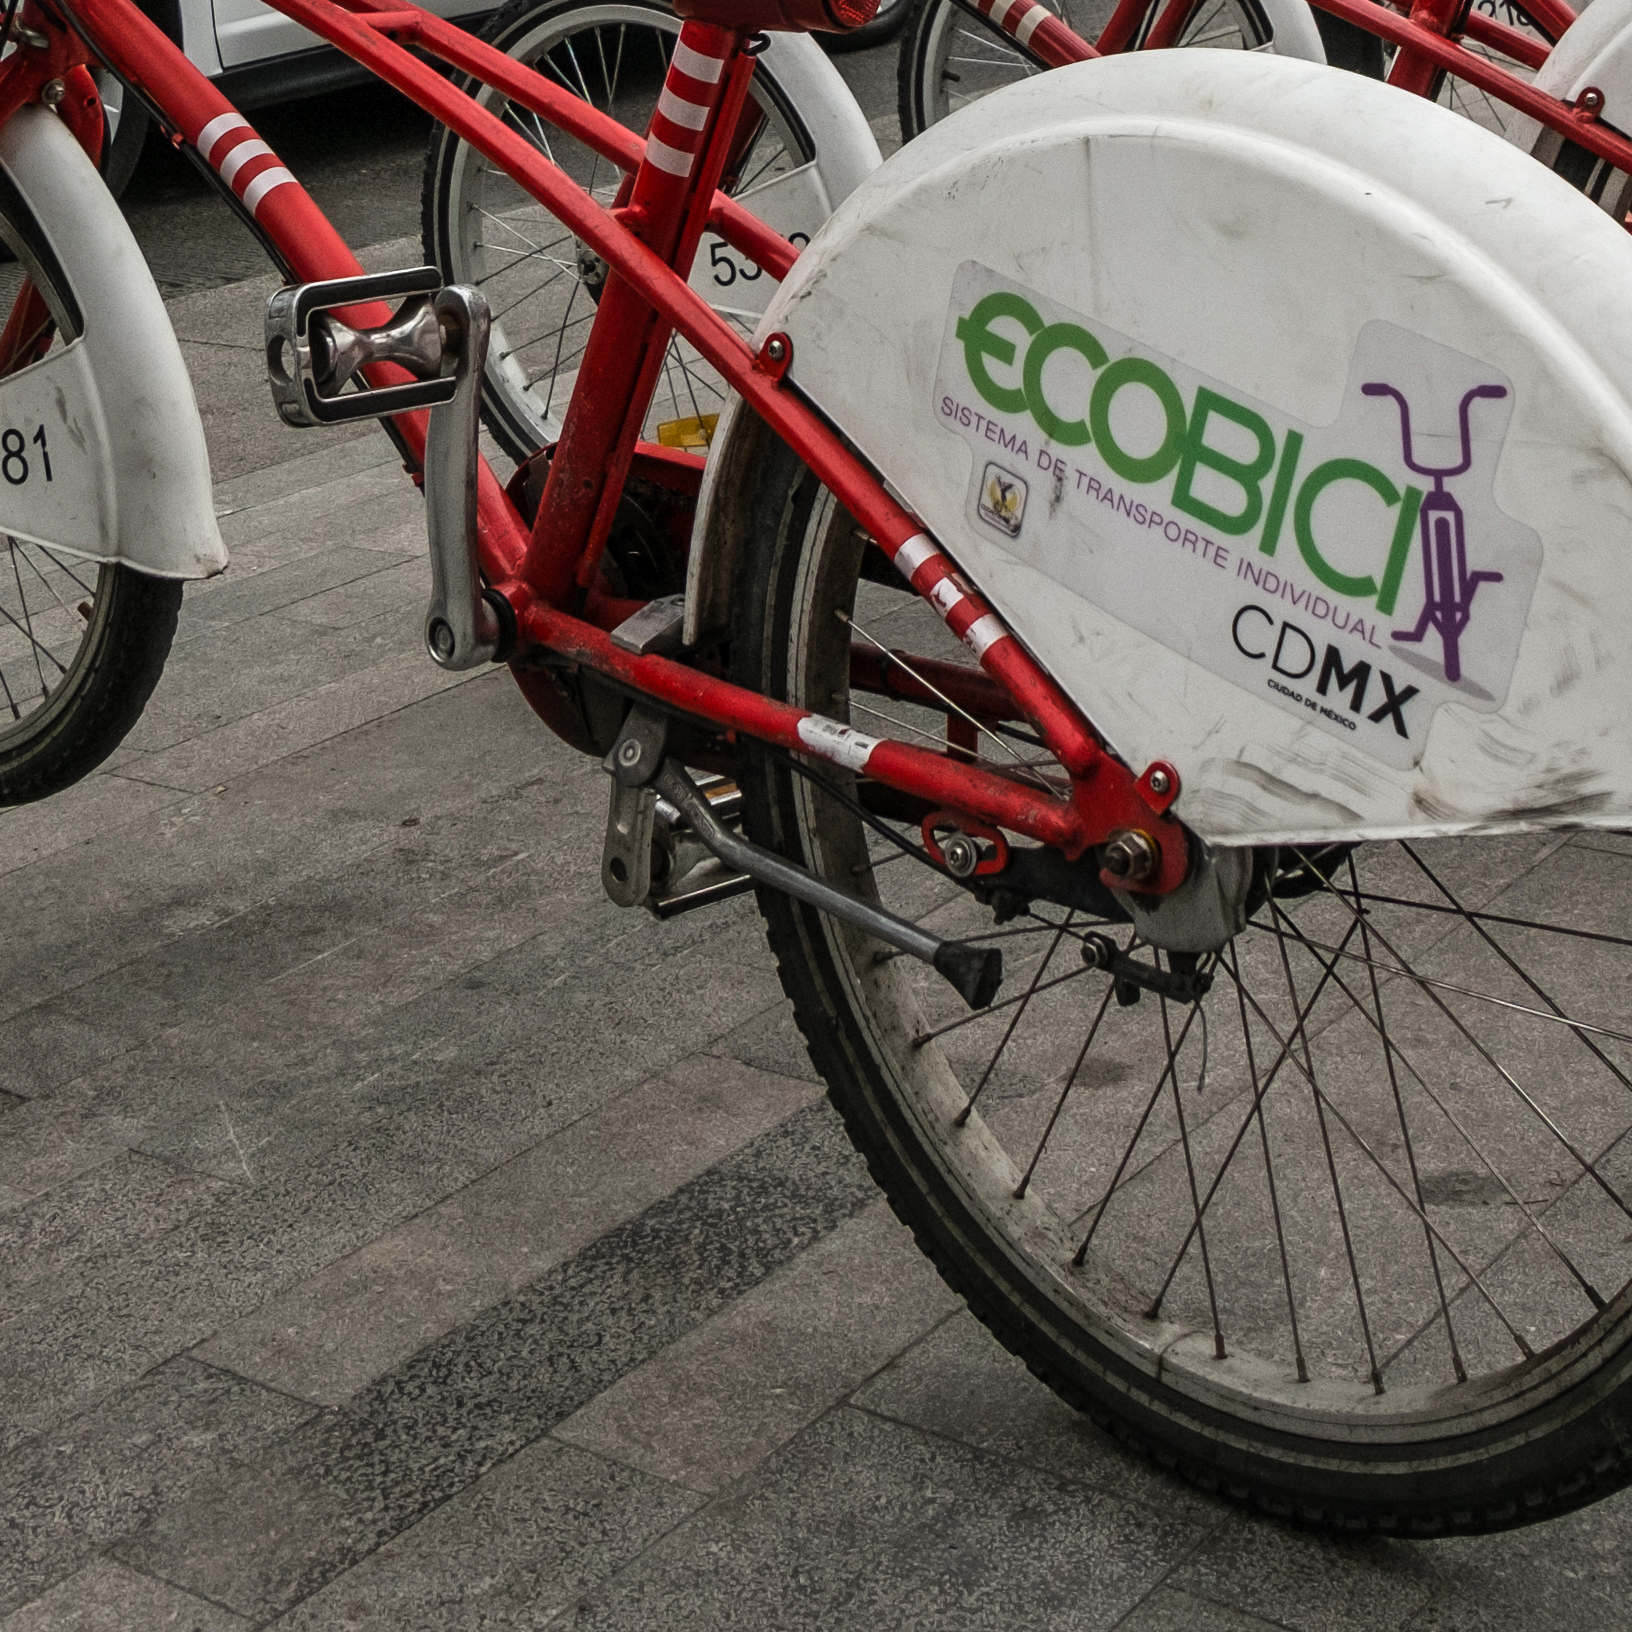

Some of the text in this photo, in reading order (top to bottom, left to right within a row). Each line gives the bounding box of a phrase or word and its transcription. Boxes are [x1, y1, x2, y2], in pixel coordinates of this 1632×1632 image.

[941, 396, 1383, 650] SISTEMA DE TRANSPORTE INDIVIDUAL
[955, 292, 1423, 616] ECOBICI
[1232, 604, 1420, 740] CDMX
[1267, 679, 1303, 704] CIUDAD
[1304, 697, 1318, 712] DE
